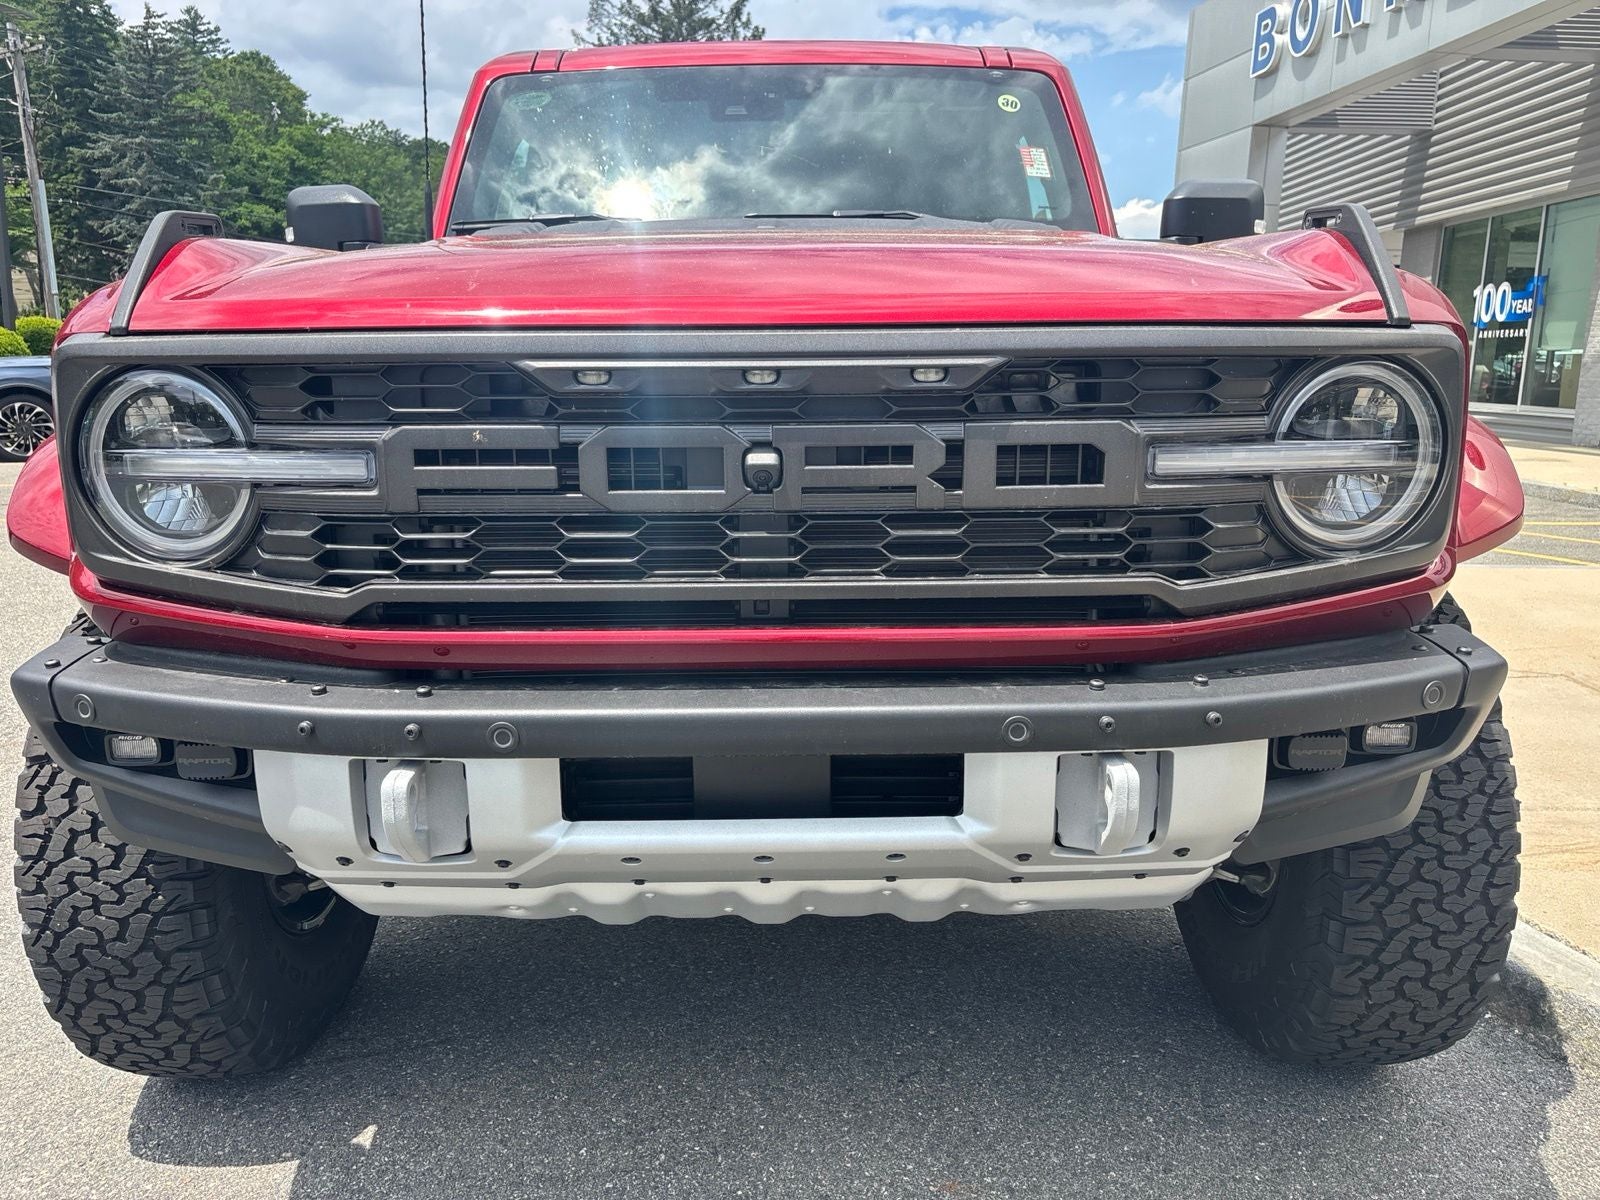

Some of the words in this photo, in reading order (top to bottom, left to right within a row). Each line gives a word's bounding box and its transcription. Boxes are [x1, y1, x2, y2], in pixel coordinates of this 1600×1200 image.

[1001, 97, 1018, 110] 30
[1473, 281, 1512, 324] 100
[1478, 328, 1528, 339] ANNIVERSARY
[382, 421, 1140, 512] FORD
[178, 757, 233, 765] RAPTOR
